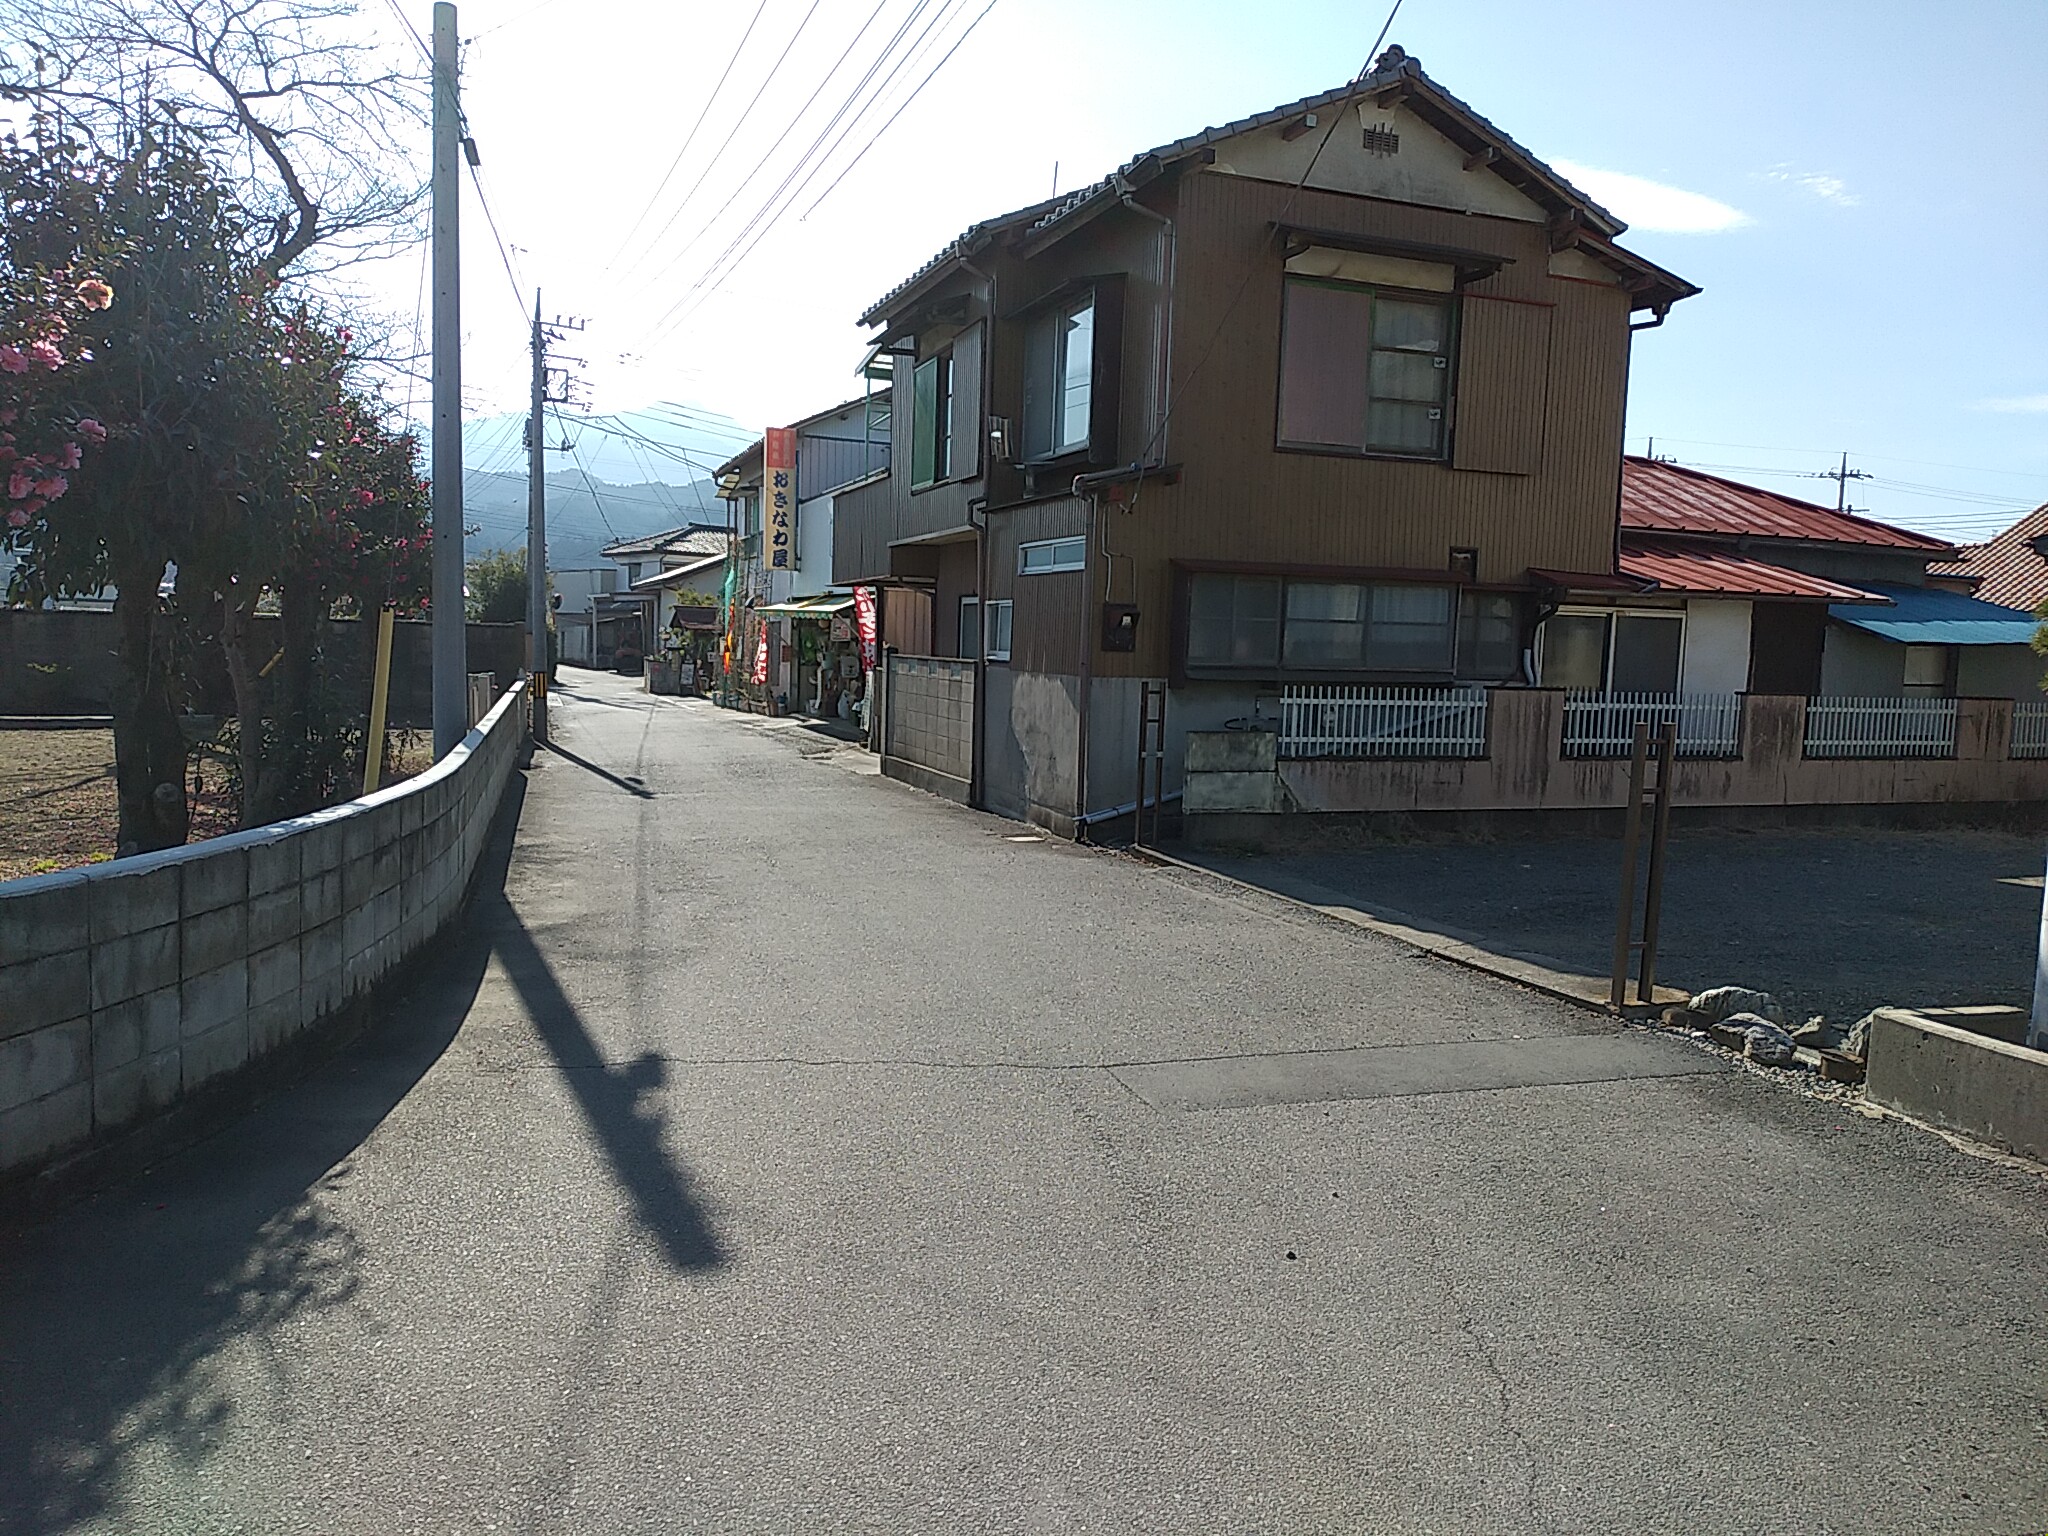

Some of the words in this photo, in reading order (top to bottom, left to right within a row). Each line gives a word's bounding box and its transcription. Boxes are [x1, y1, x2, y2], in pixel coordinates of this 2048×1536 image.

[772, 470, 789, 568] おきなわ屋
